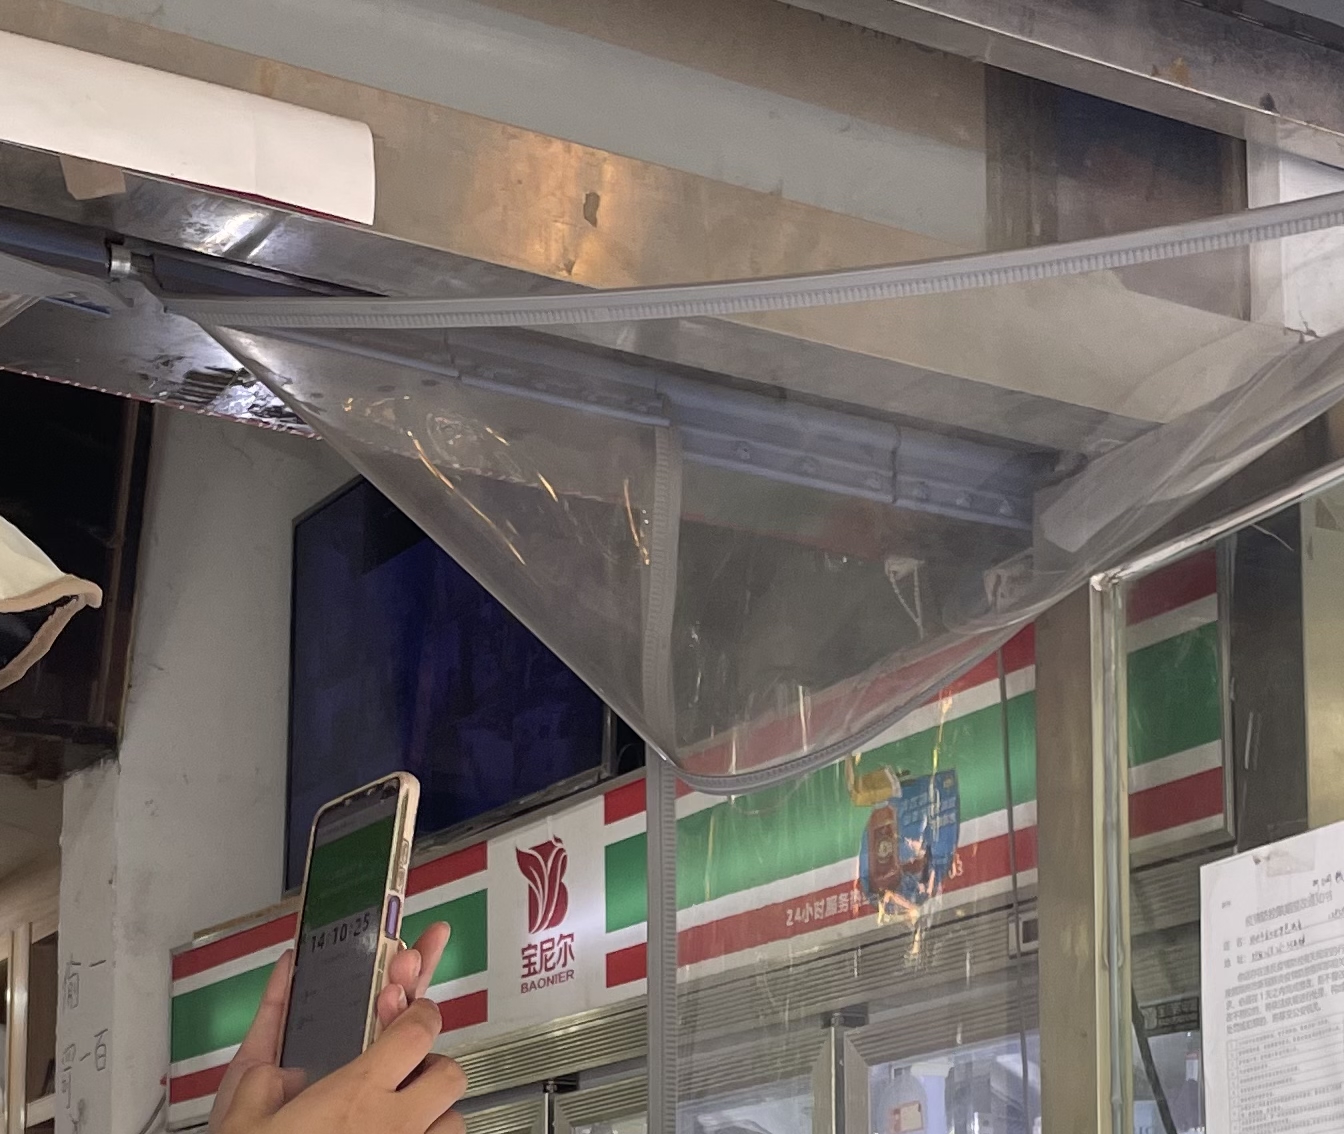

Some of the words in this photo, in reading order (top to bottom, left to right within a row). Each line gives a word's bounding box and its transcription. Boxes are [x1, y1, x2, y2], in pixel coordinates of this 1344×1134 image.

[521, 933, 575, 978] 宝尼尔
[520, 969, 575, 994] BAONIER
